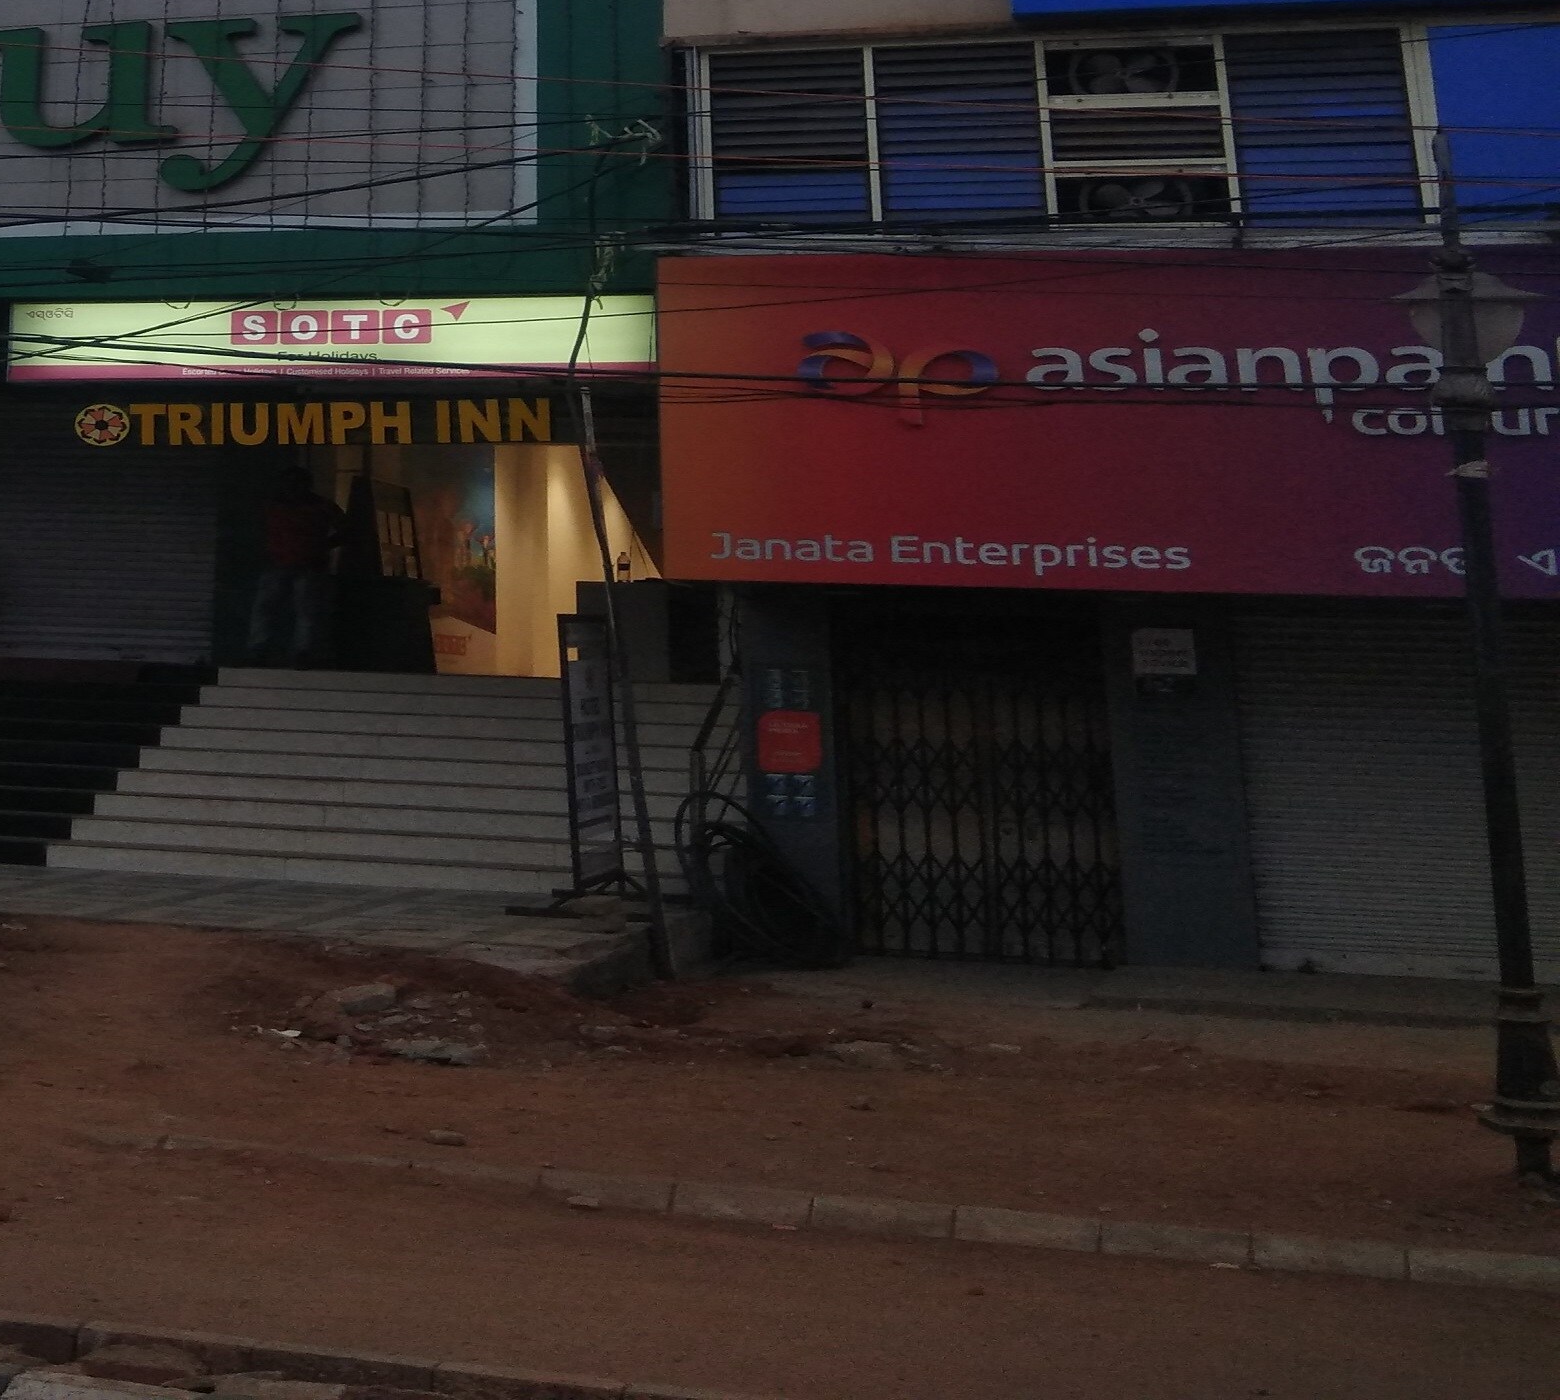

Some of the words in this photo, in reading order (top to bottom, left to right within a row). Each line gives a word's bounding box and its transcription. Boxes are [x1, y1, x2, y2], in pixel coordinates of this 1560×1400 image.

[242, 313, 423, 342] SOTC
[378, 367, 402, 375] Travel
[130, 399, 416, 446] TRIUMPH
[435, 397, 553, 444] INN
[710, 531, 875, 566] Janata
[890, 534, 1193, 577] Enterprises
